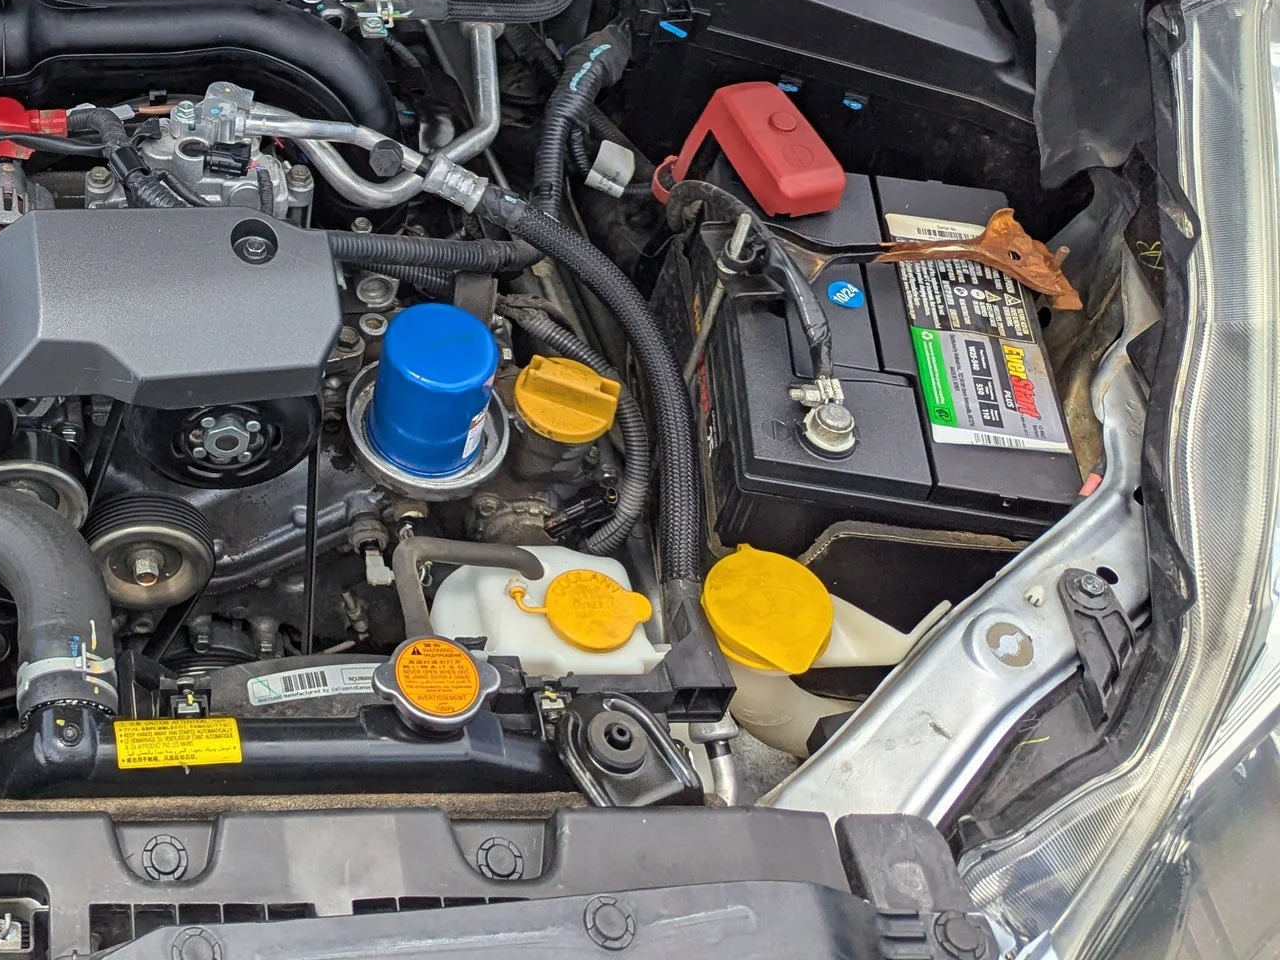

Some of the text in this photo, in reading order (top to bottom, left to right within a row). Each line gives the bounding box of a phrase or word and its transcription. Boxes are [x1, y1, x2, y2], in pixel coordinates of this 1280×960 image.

[834, 284, 860, 304] 10/24
[1003, 390, 1014, 408] PLUS
[982, 409, 990, 420] 110
[552, 572, 620, 596] COOLANT
[284, 690, 321, 698] Manufactured
